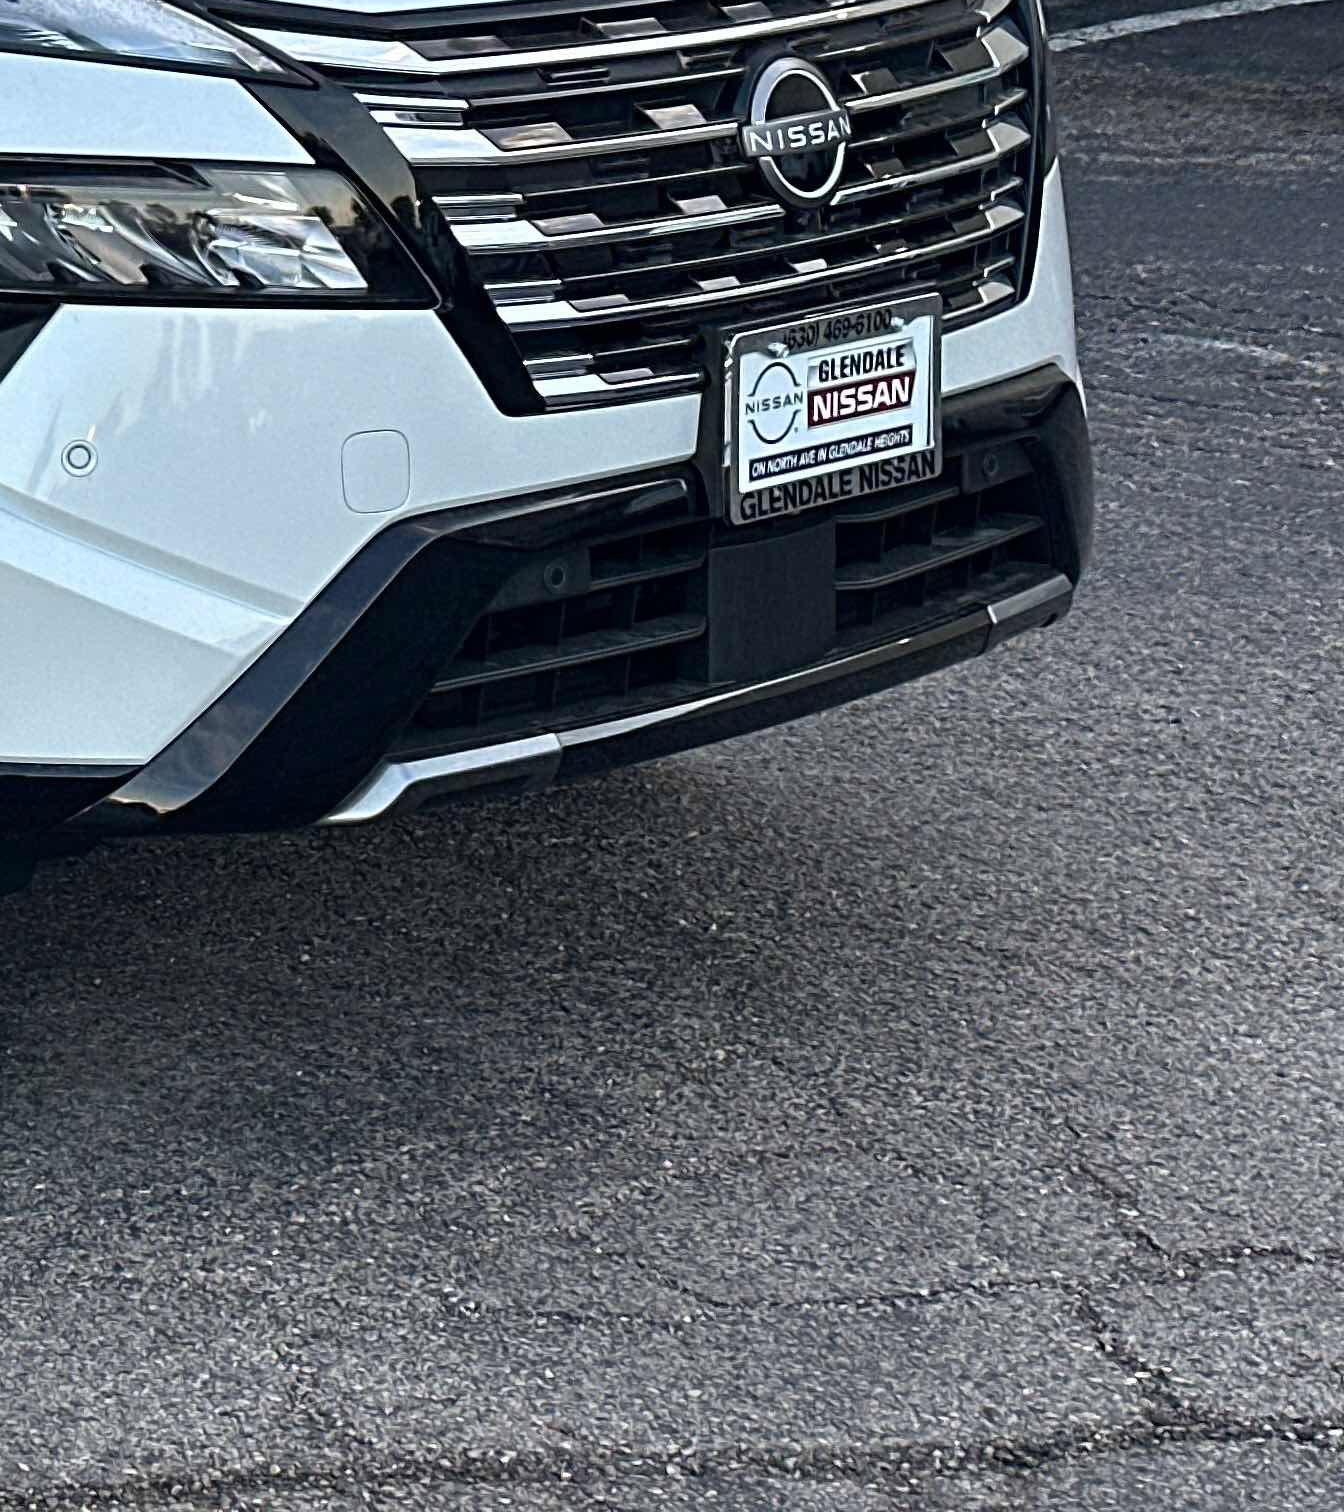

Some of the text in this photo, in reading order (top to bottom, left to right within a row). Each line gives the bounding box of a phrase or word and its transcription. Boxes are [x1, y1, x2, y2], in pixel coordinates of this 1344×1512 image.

[749, 115, 852, 153] NISSAN
[823, 309, 894, 341] 469-6100
[818, 344, 906, 383] GLENDALE
[745, 392, 804, 414] NISSAN
[813, 377, 910, 422] NISSAN
[751, 429, 911, 478] ON NORTH AVE IN GLENDALE HEIGHTS
[740, 450, 936, 521] GLENDALE NISSAN
